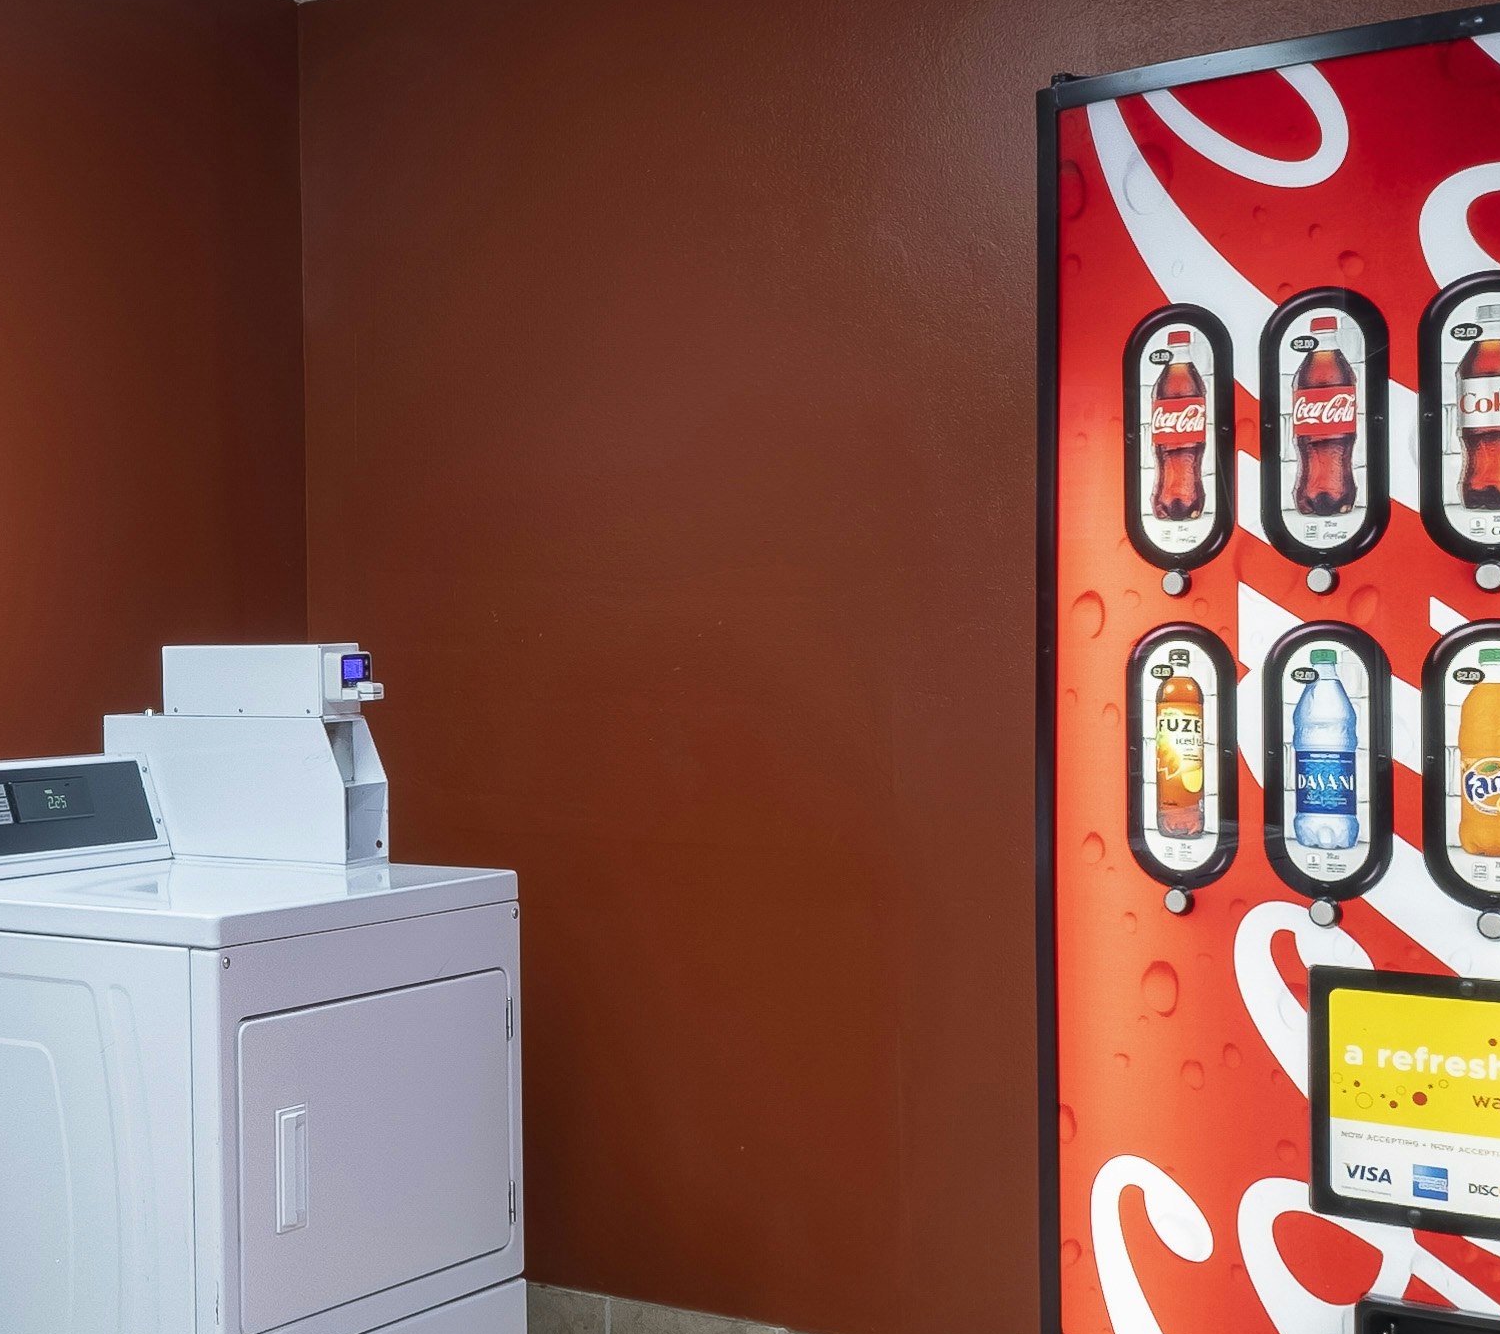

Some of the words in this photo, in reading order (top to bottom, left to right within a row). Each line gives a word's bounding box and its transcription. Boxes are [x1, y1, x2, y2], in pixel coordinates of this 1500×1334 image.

[1152, 404, 1206, 434] Coca-Cola
[1293, 393, 1356, 424] Coca-Cola
[1158, 718, 1202, 734] FUZE
[1298, 773, 1354, 791] DASANI
[1344, 1044, 1364, 1066] a
[1341, 1130, 1364, 1139] NOW
[1366, 1133, 1419, 1148] ACCEPTING
[1430, 1142, 1454, 1152] NOW
[1343, 1162, 1392, 1185] VISA
